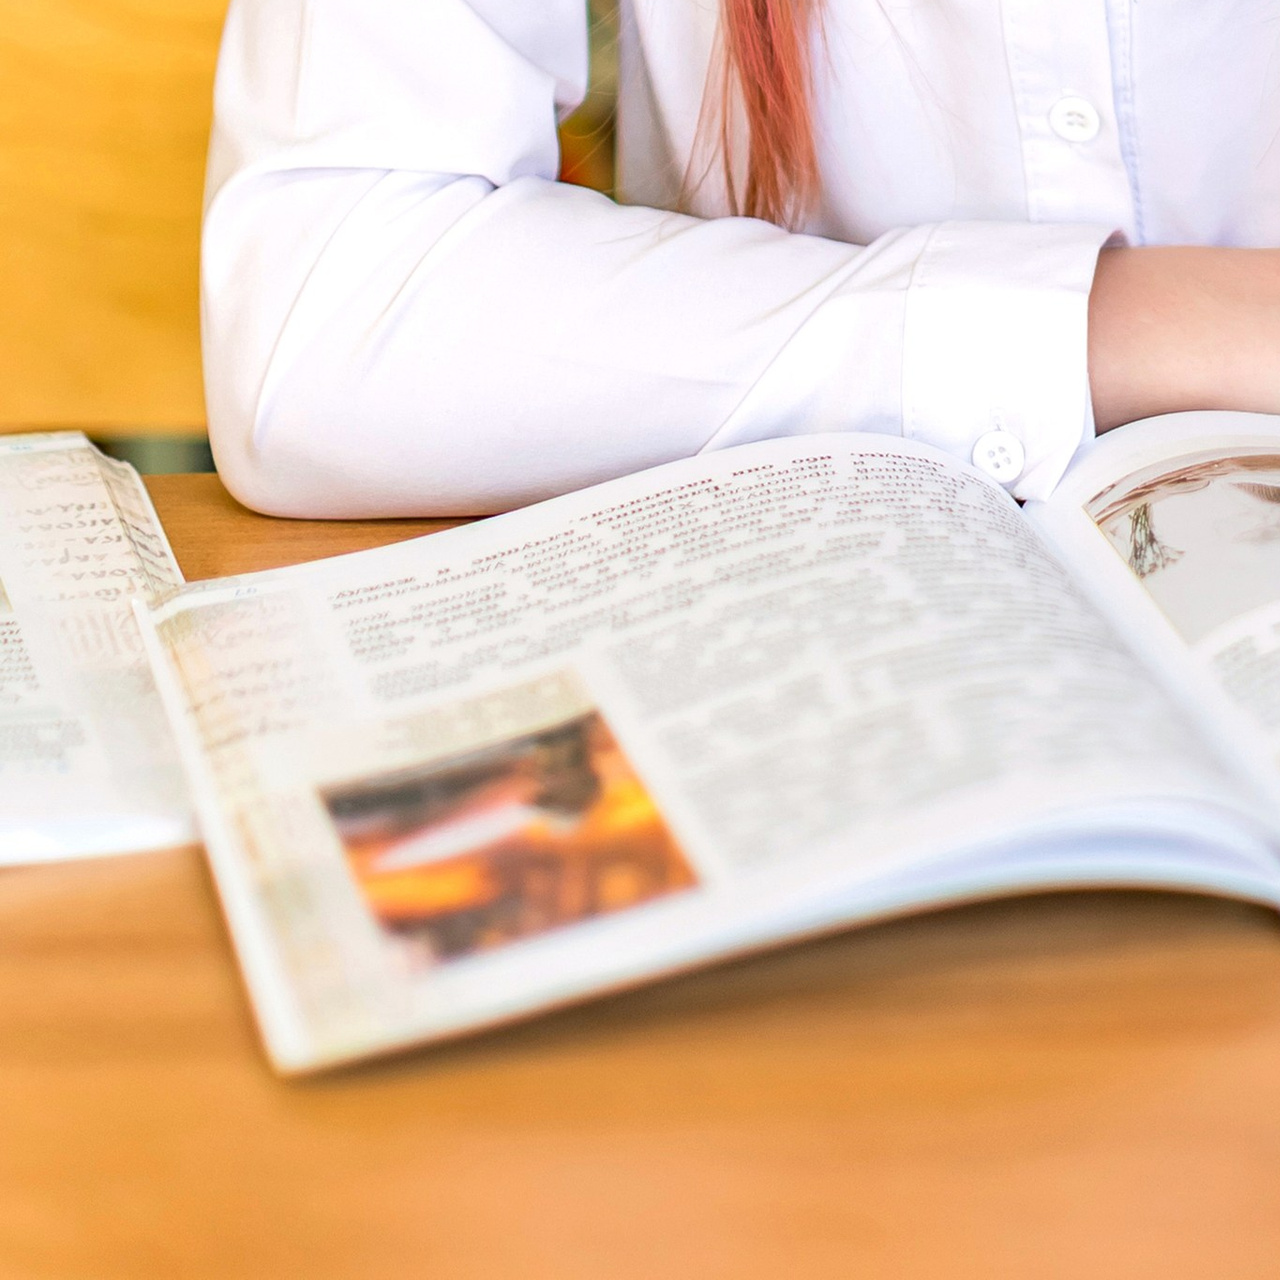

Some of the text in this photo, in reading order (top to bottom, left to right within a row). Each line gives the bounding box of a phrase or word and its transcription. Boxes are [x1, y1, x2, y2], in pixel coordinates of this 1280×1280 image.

[732, 462, 772, 478] они
[791, 453, 831, 465] ибо
[714, 468, 835, 500] проповеди
[595, 480, 732, 527] «Блаженны
[610, 500, 693, 532] Христа
[622, 482, 799, 538] окружающими
